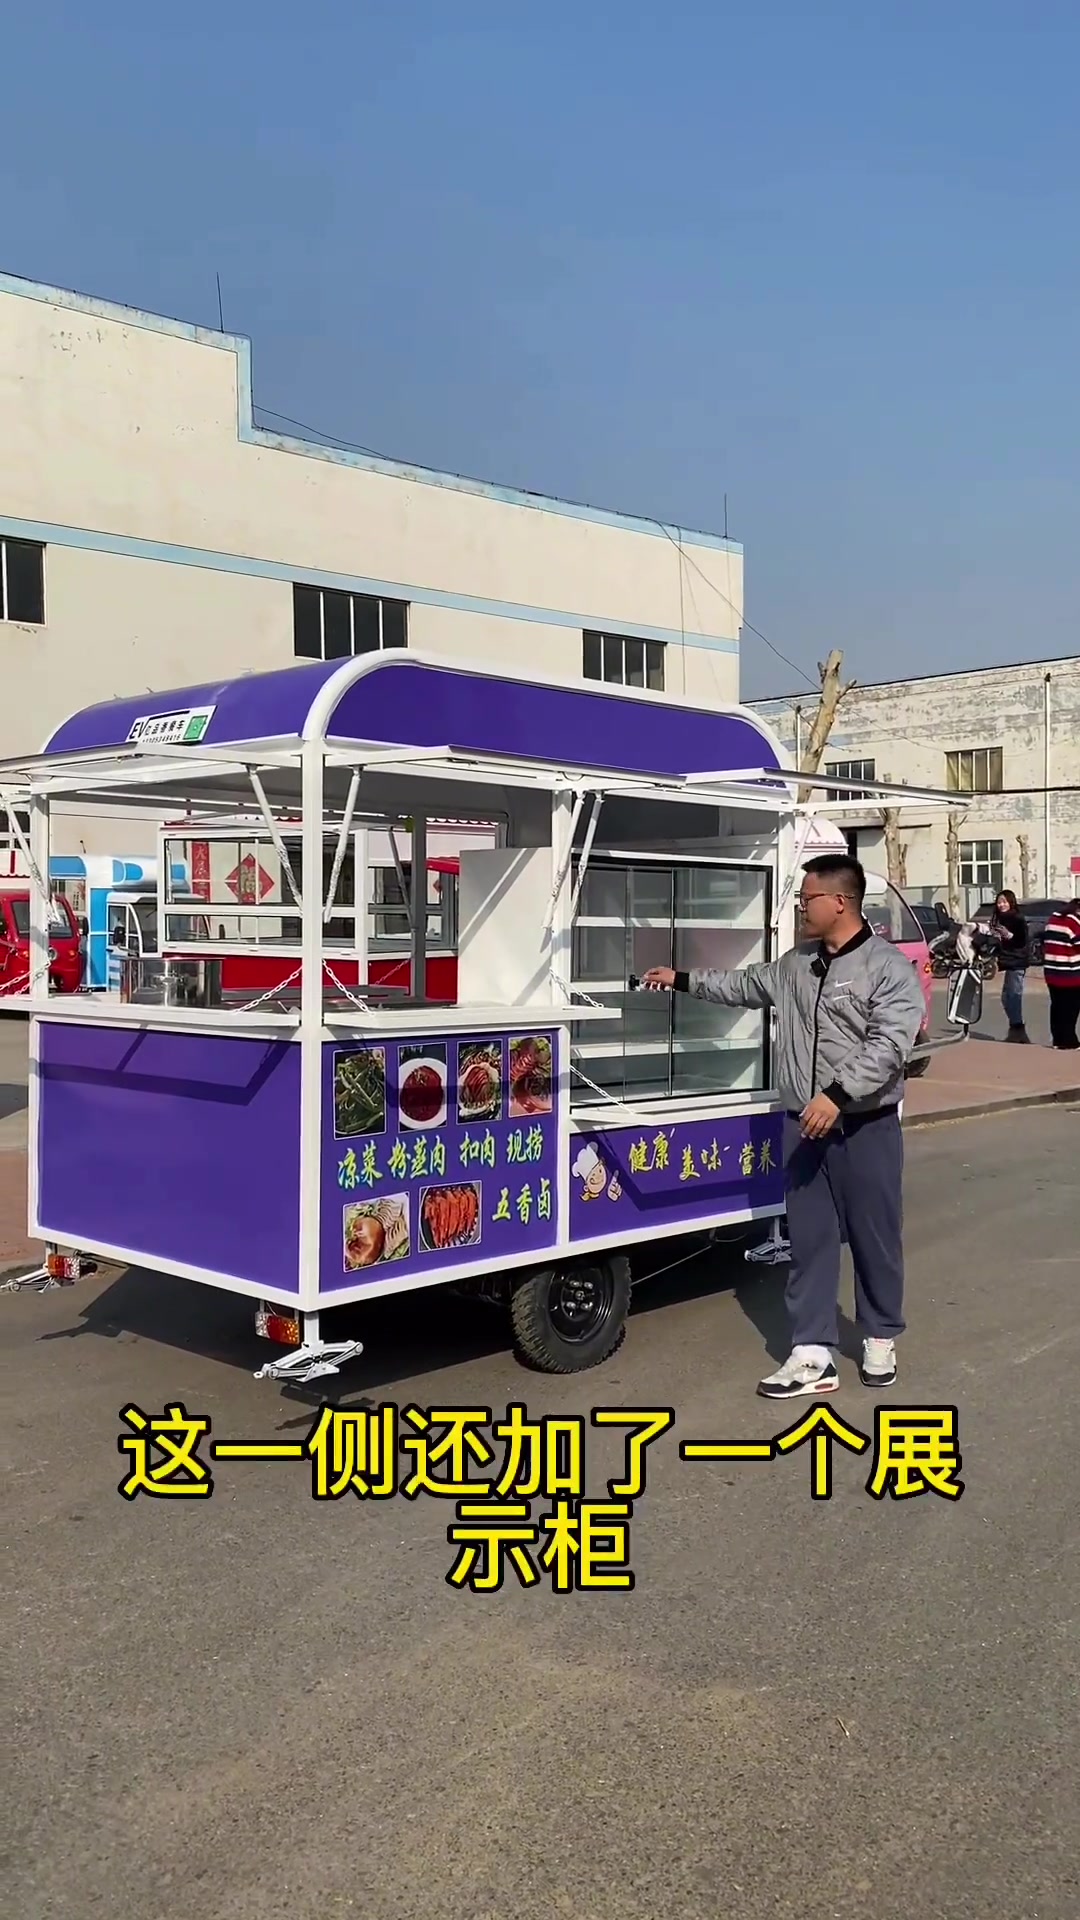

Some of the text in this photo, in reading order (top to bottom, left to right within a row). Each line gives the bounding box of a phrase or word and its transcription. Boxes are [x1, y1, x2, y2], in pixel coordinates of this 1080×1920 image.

[387, 1134, 446, 1180] 粉蒸肉
[459, 1127, 495, 1169] 扣肉
[505, 1122, 544, 1164] 现捞
[628, 1130, 777, 1182] 健康 美味 营养
[491, 1176, 553, 1225] 五香卤
